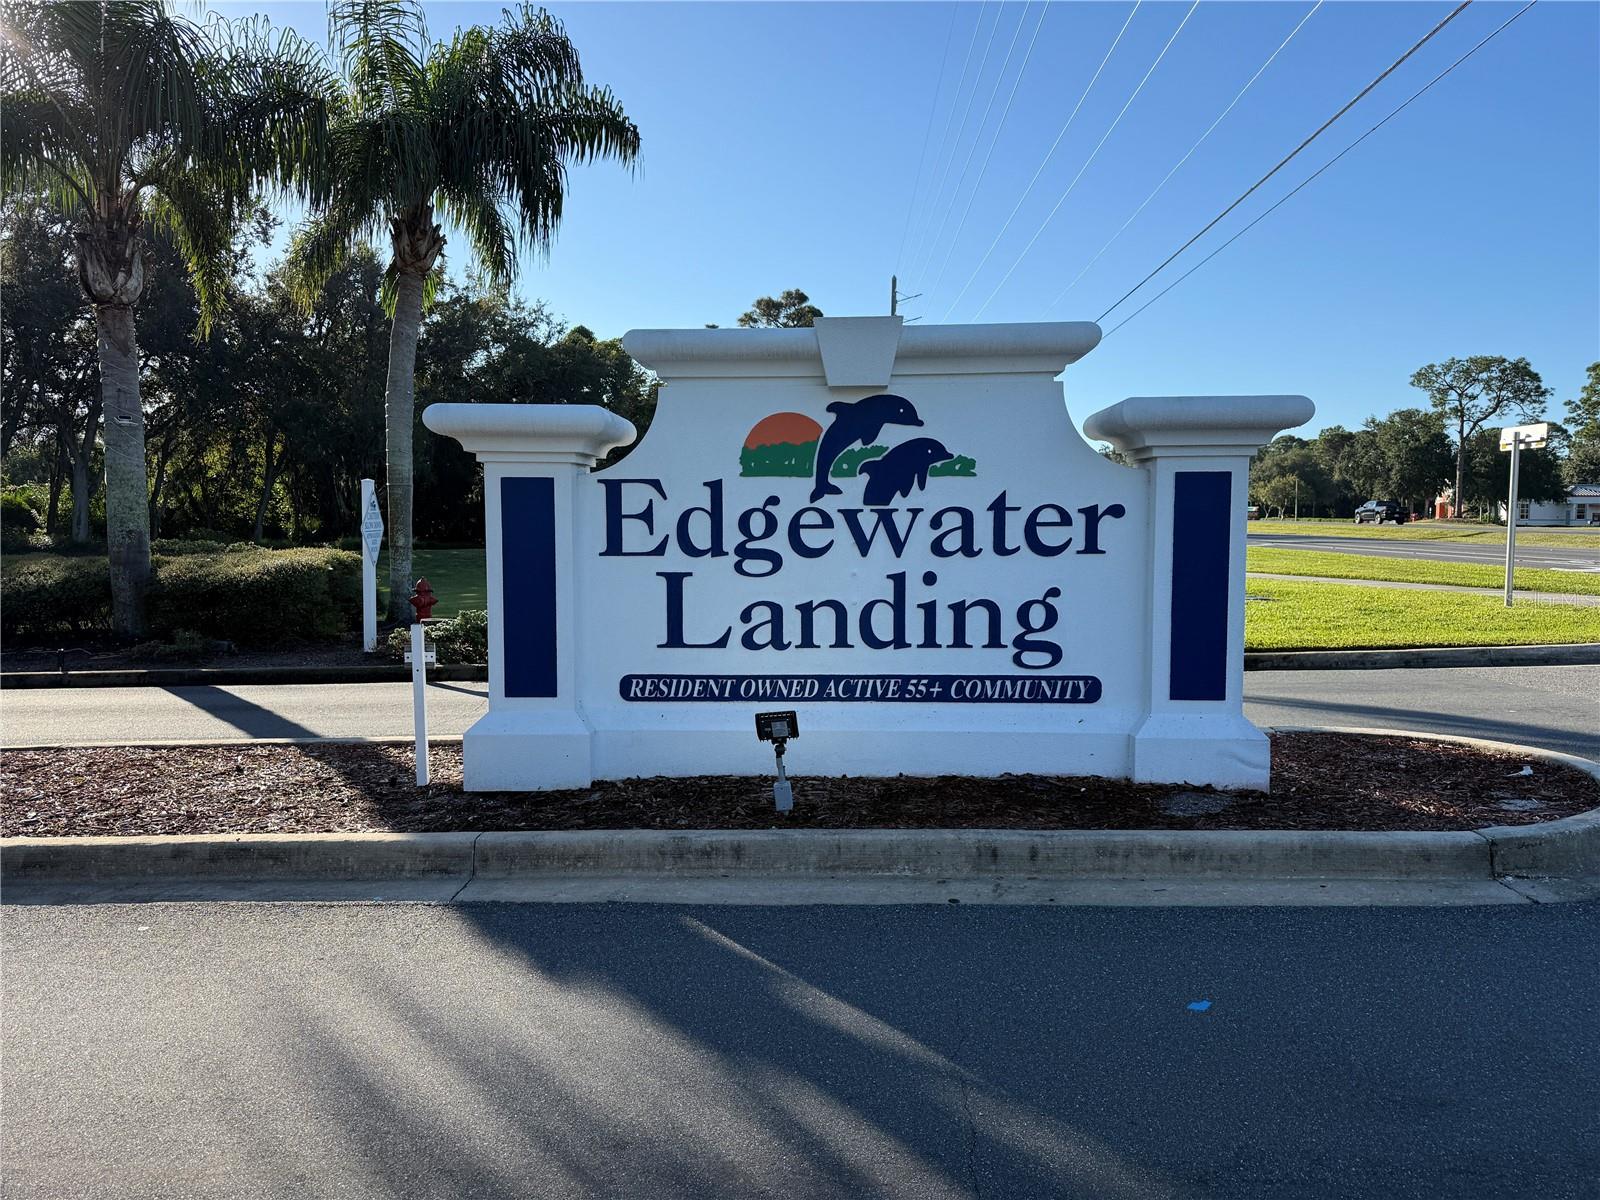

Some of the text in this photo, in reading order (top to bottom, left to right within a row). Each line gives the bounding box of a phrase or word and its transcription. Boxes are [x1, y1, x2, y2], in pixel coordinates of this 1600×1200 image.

[597, 478, 1126, 578] Edgewater
[656, 570, 1063, 669] Landing
[629, 678, 1092, 699] RESIDENT OWNED ACTIVE 55+ COMMUNITY
